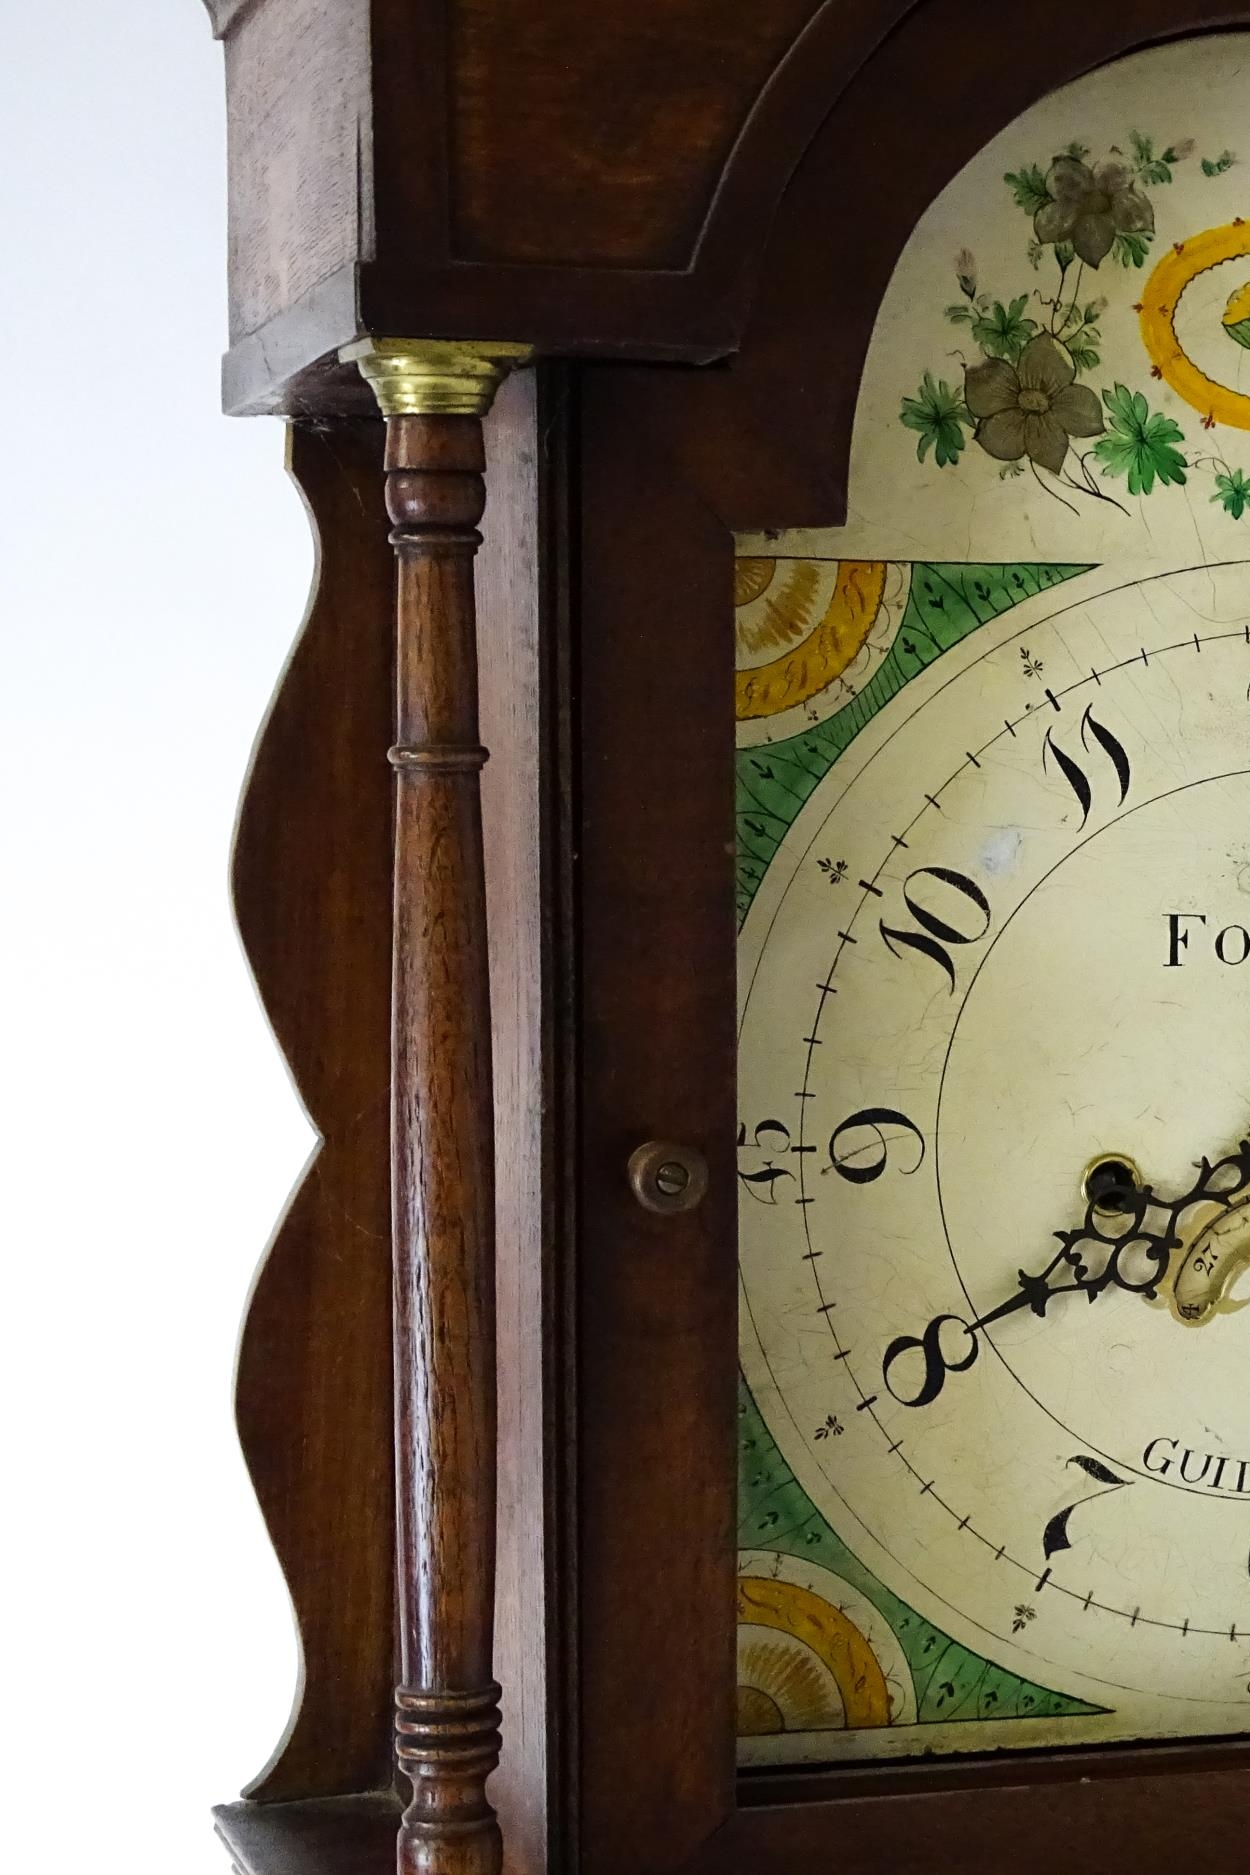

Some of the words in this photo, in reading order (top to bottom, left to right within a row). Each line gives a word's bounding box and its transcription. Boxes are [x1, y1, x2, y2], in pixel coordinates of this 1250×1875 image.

[1042, 702, 1131, 832] 11
[879, 866, 990, 997] 10
[737, 1119, 797, 1206] 45
[829, 1107, 925, 1184] 9
[1193, 1242, 1219, 1277] 27
[882, 1314, 979, 1408] 8
[1042, 1454, 1136, 1562] 7
